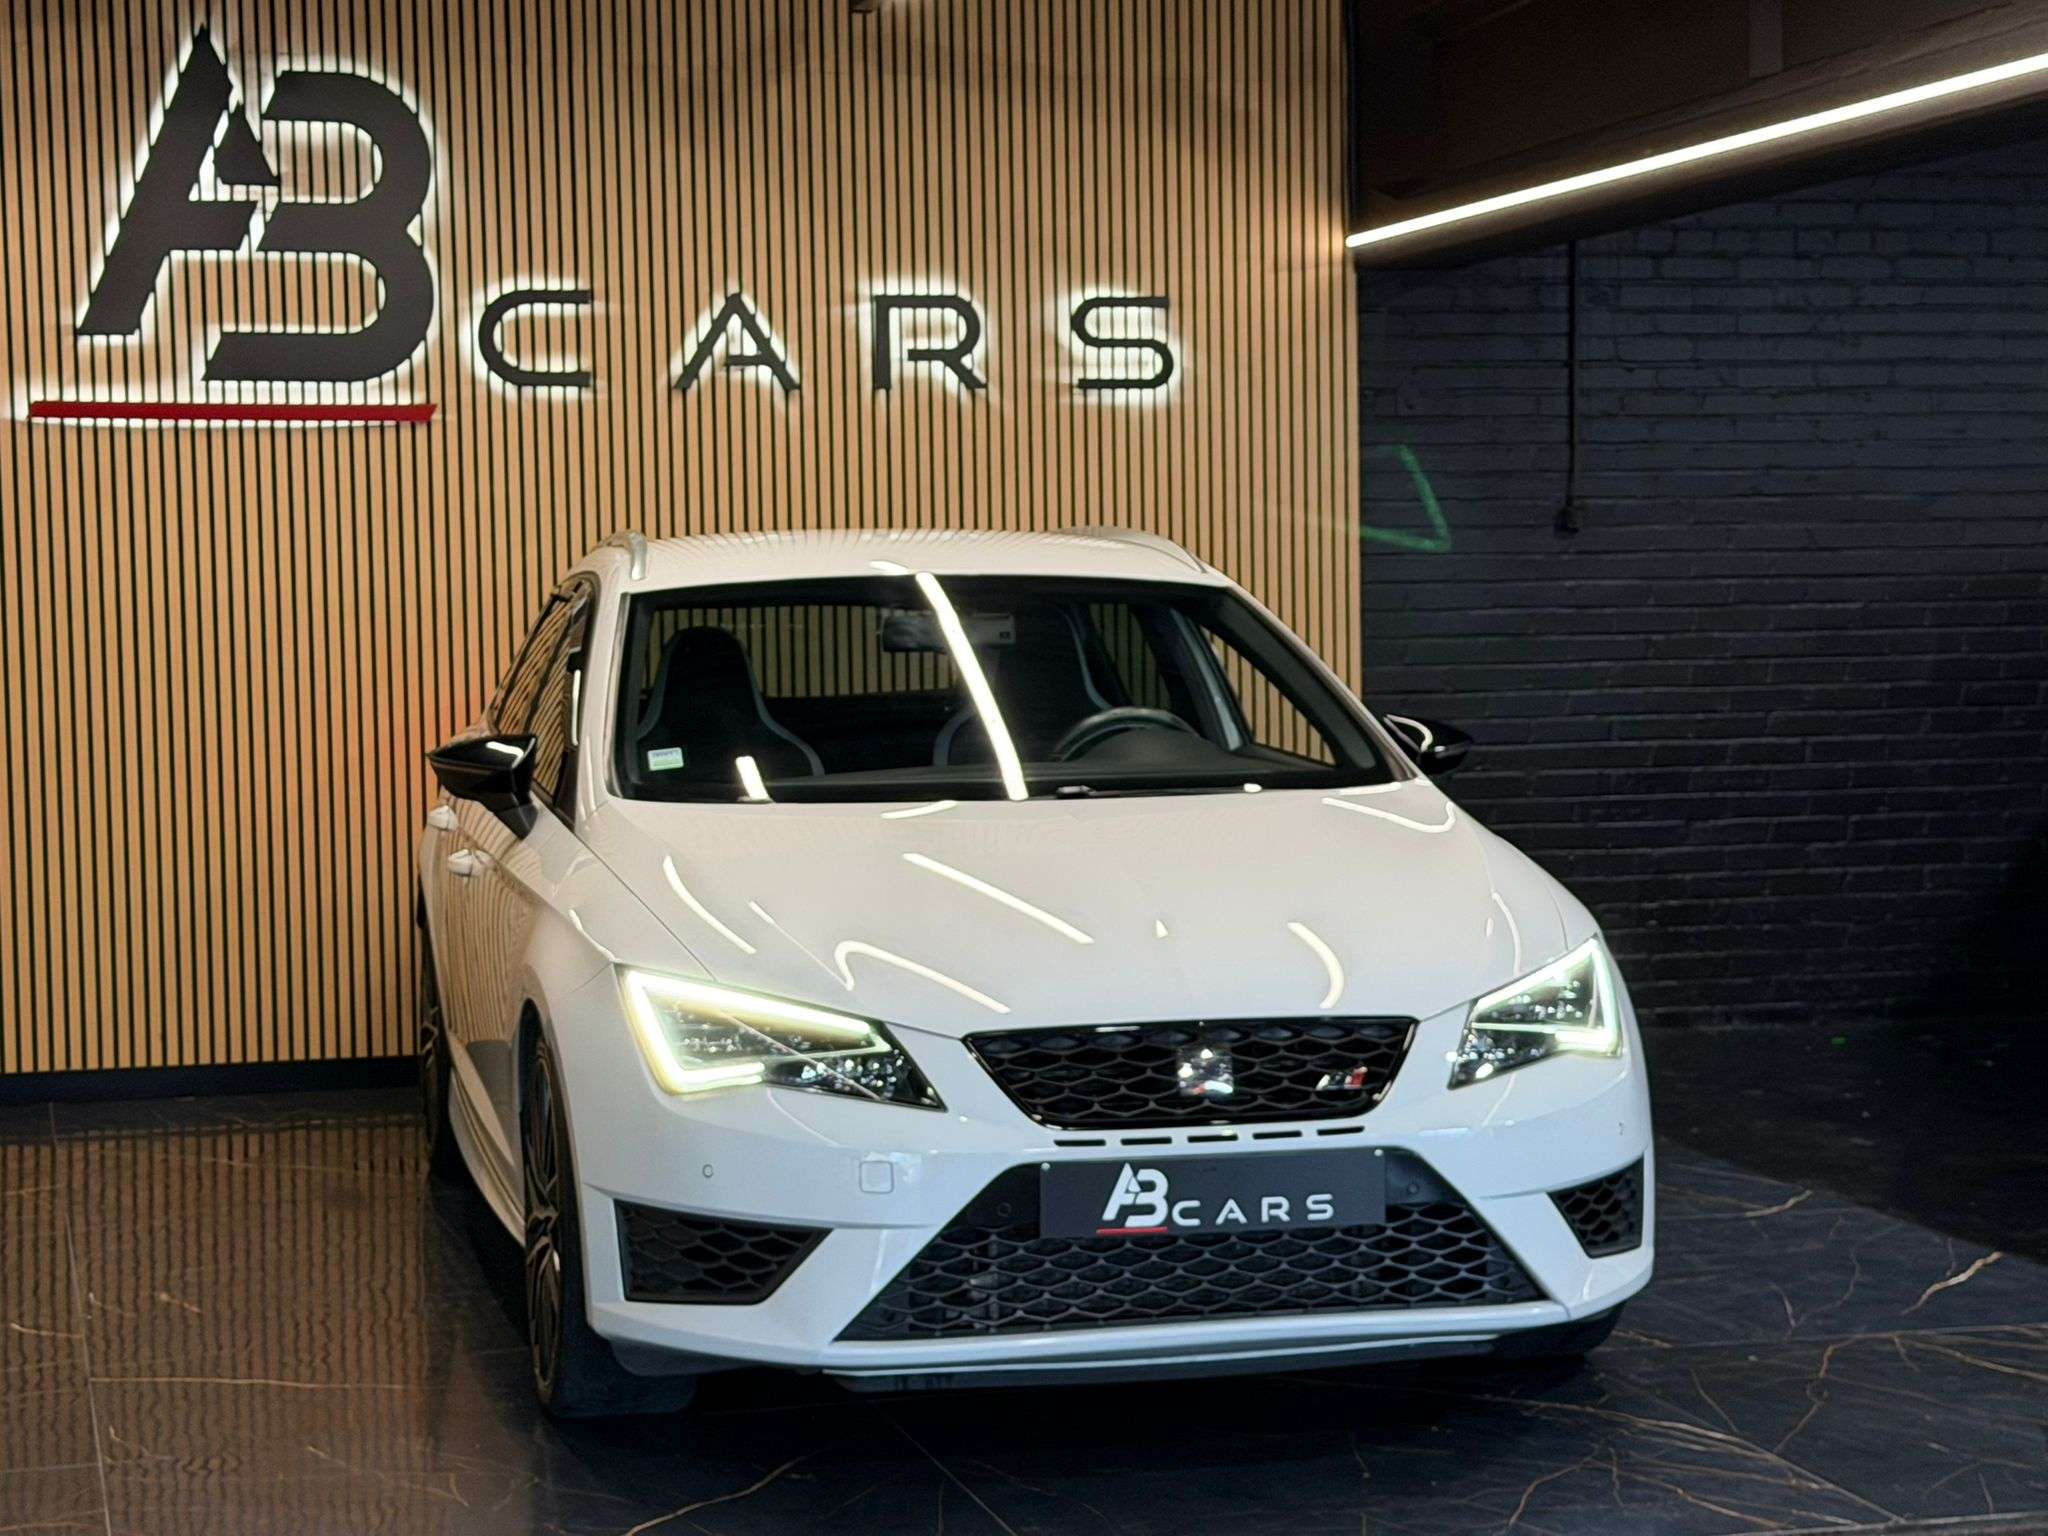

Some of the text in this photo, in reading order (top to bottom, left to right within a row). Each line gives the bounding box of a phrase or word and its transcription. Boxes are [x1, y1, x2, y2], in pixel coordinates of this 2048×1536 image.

[77, 24, 1174, 391] AB CARS
[1102, 1162, 1334, 1228] AB CARS
